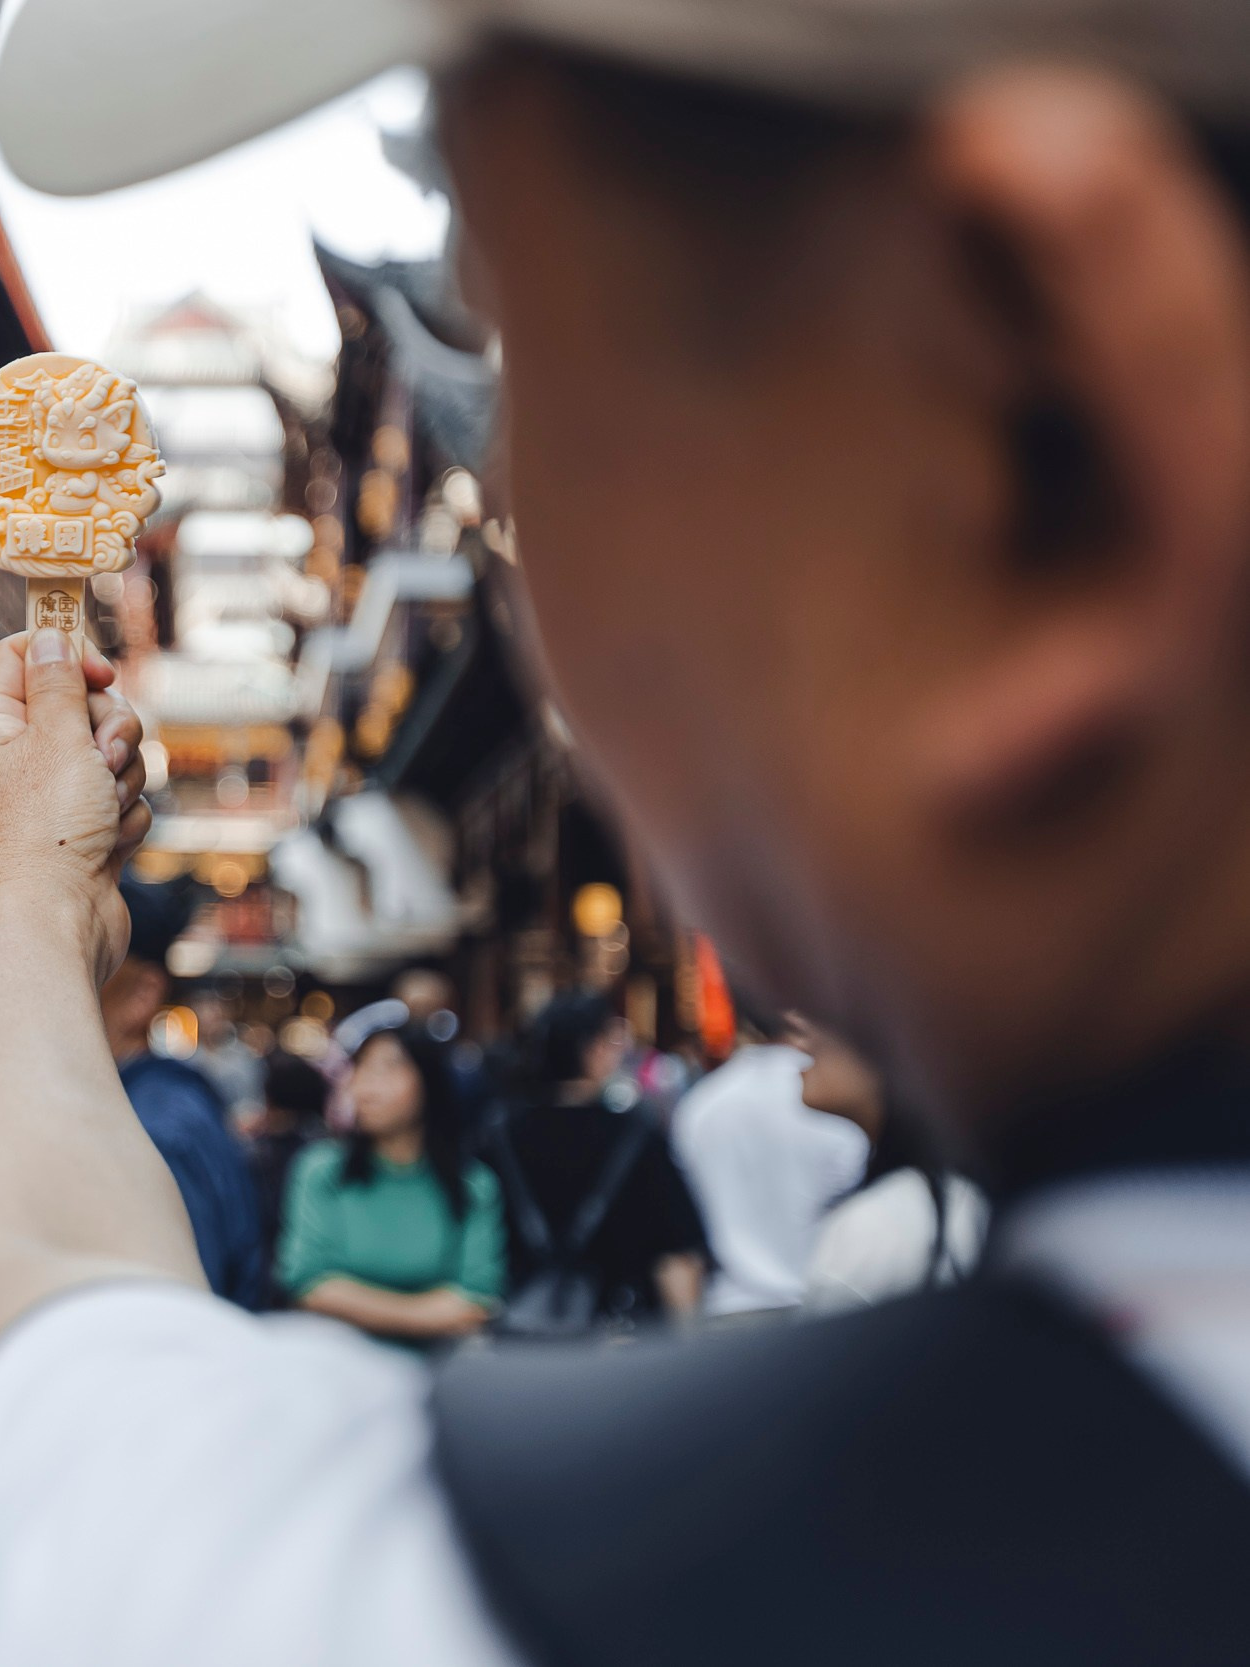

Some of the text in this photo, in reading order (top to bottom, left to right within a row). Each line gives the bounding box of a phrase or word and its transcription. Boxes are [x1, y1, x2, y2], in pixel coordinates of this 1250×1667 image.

[14, 517, 84, 555] 豫园
[40, 596, 75, 613] 豫园
[40, 615, 75, 632] 制造
